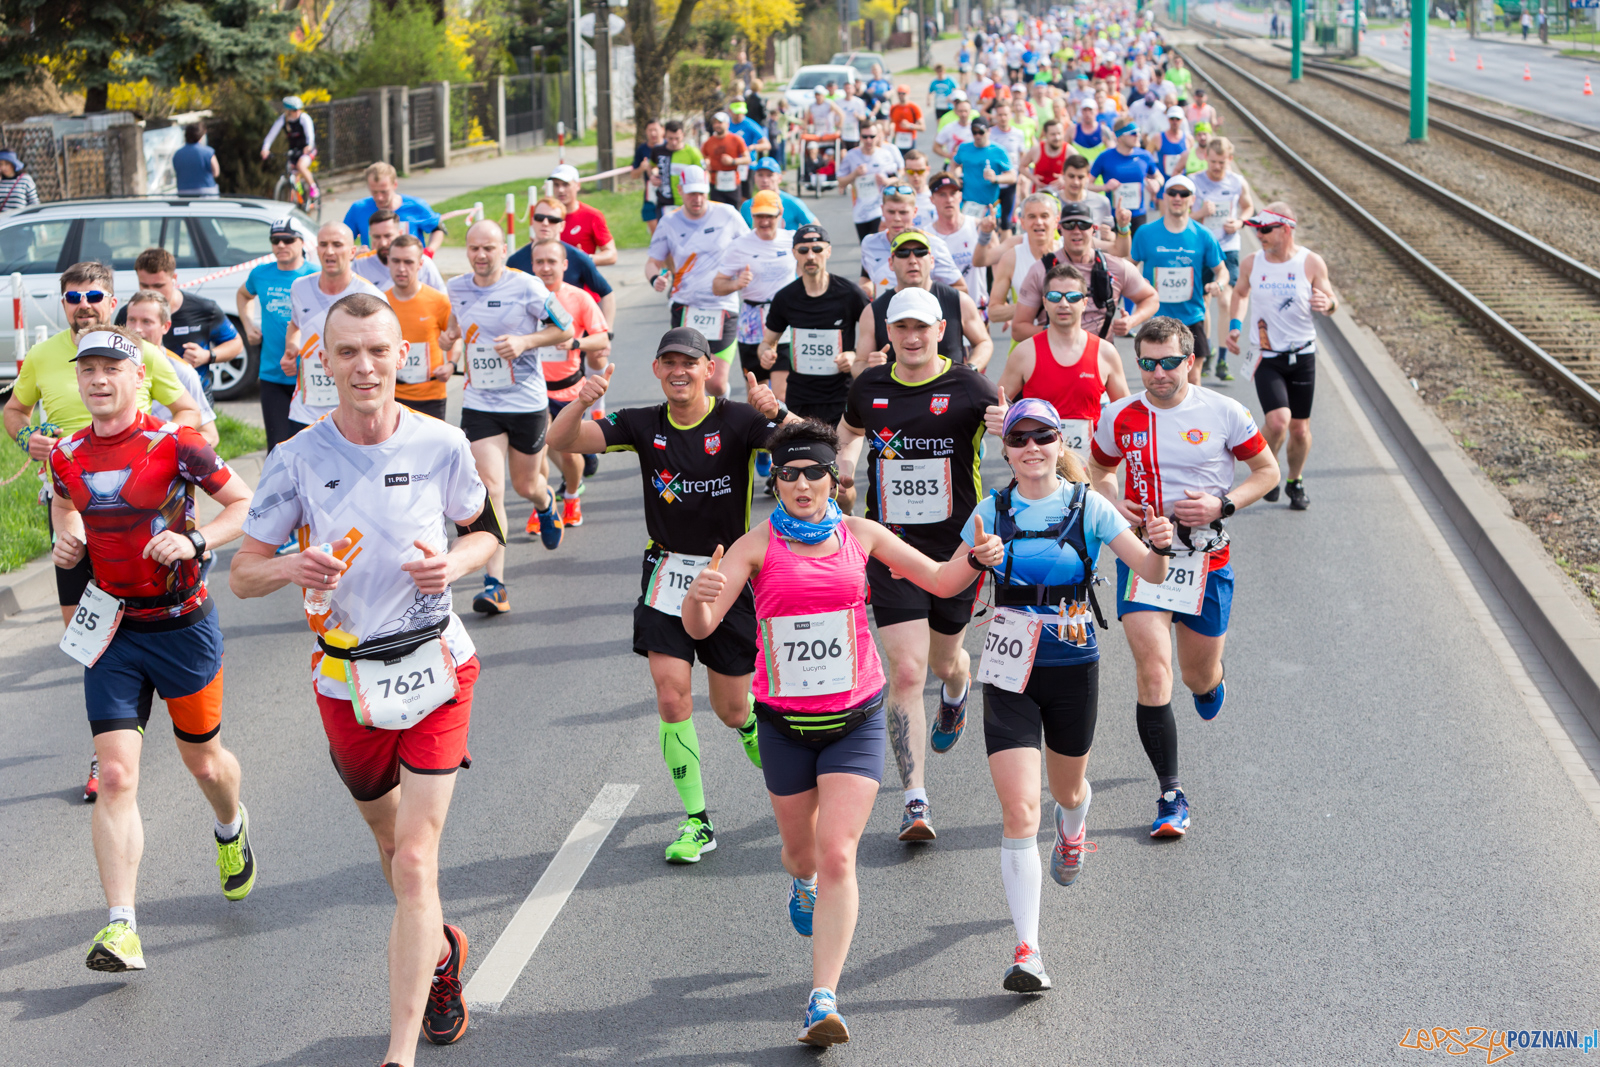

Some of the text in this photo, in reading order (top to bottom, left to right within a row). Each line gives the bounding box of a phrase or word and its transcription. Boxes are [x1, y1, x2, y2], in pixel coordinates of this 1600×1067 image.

[1162, 278, 1188, 288] 4369
[693, 315, 716, 325] 9271
[801, 343, 834, 356] 2558
[473, 357, 503, 370] 8301
[933, 448, 954, 456] team
[711, 487, 732, 497] team
[891, 479, 939, 496] 3883
[783, 637, 842, 662] 7206
[802, 664, 827, 673] Lucyna
[377, 667, 435, 699] 7621
